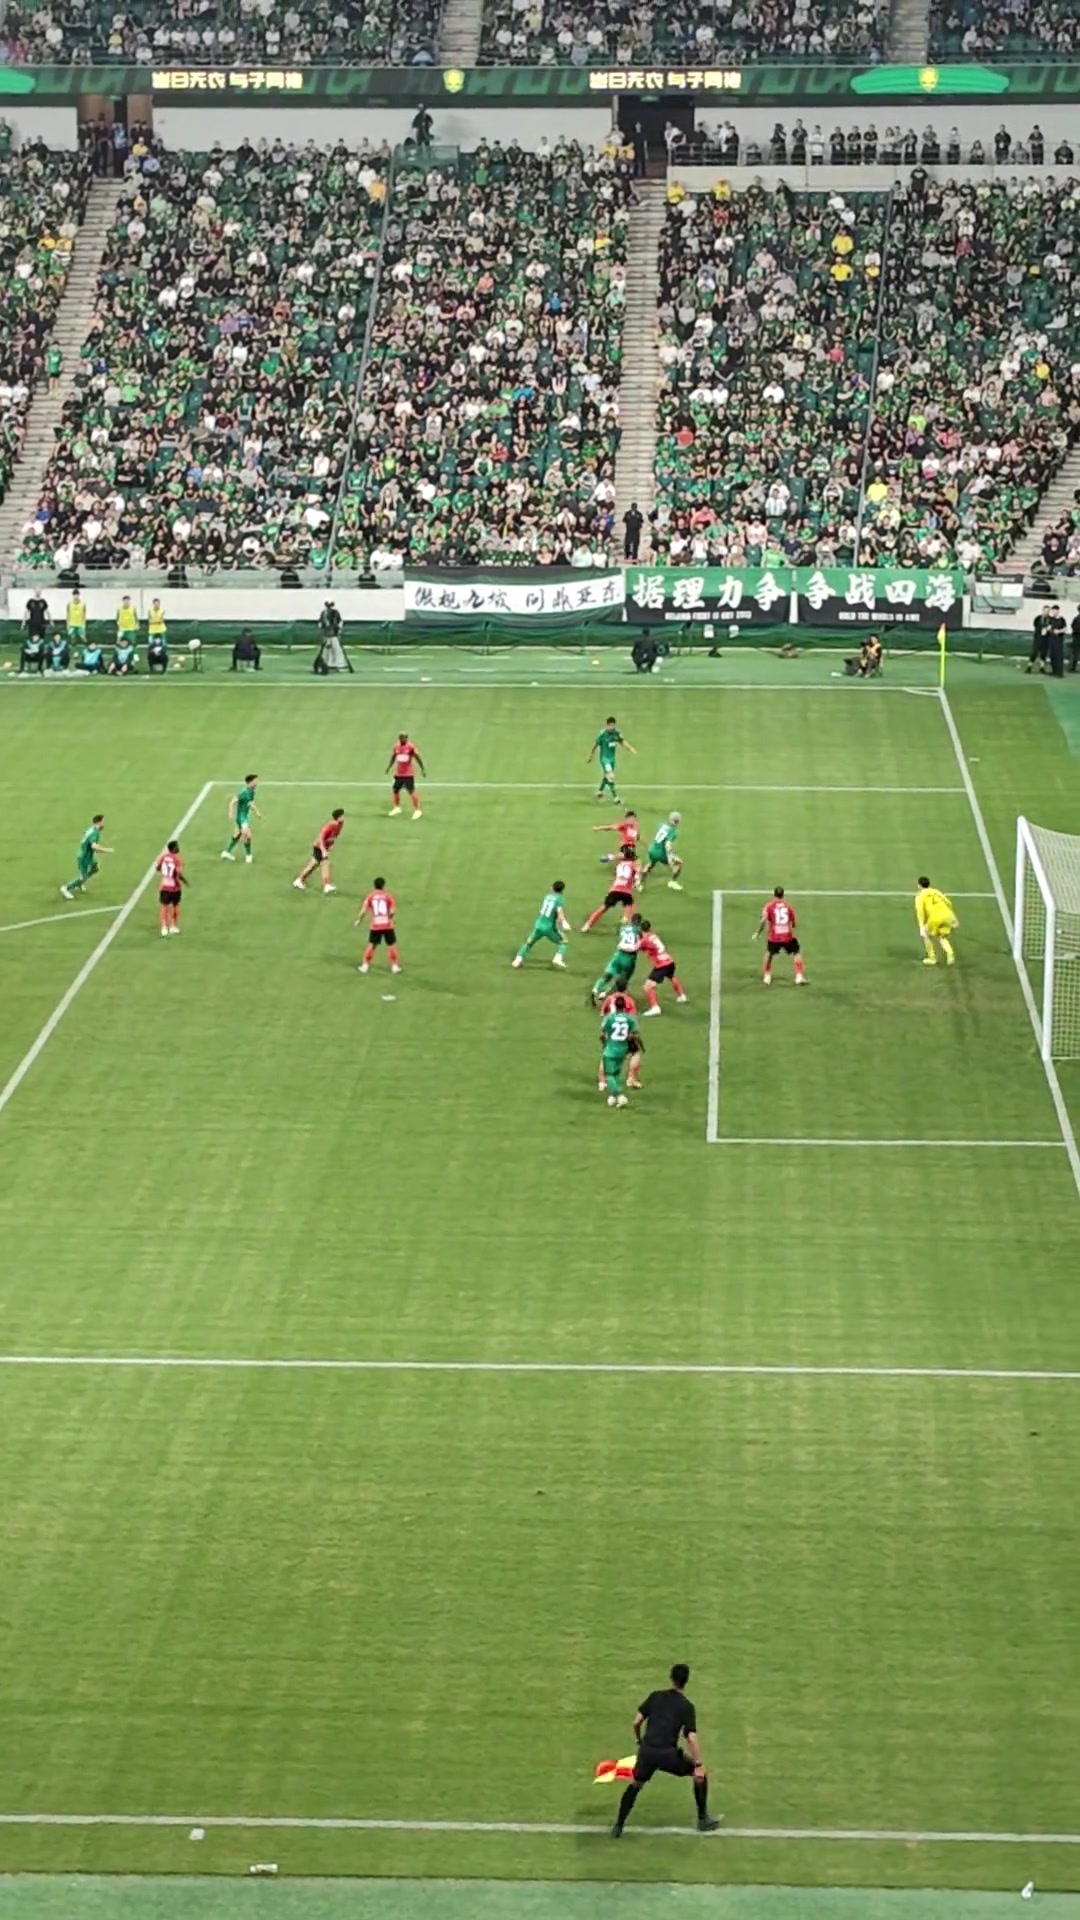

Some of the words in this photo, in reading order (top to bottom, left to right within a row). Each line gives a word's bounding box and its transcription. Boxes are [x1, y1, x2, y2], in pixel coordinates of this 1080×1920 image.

[632, 571, 787, 611] 据理力争
[804, 571, 956, 612] 争战四海
[371, 899, 388, 914] 14
[774, 908, 788, 924] 15
[612, 1024, 629, 1040] 23
